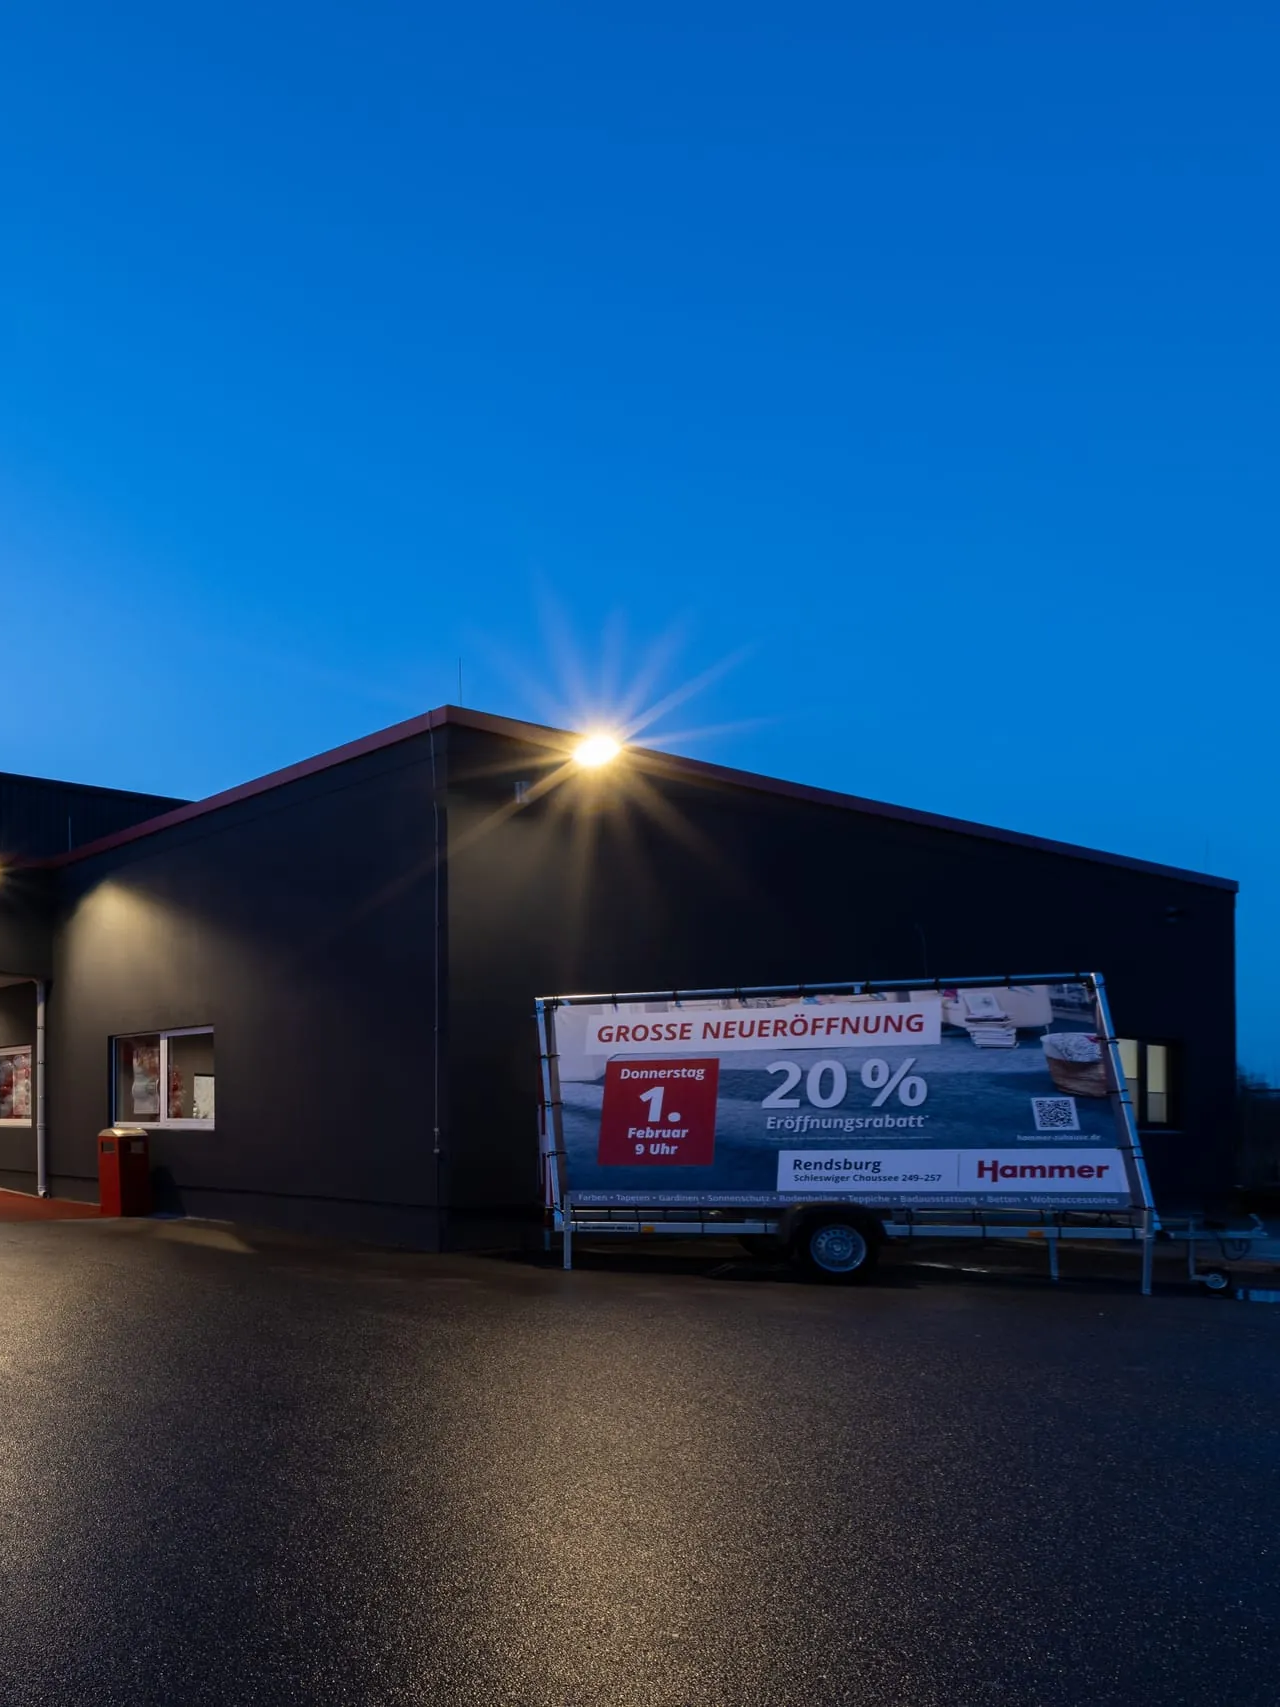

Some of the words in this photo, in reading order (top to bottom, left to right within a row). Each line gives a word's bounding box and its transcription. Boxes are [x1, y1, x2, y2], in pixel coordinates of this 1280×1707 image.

[598, 1022, 693, 1043] GROSSE
[702, 1013, 925, 1039] NEUERÖFFNUNG
[620, 1068, 706, 1081] Donnerstag
[761, 1060, 848, 1109] 20
[861, 1058, 928, 1107] %
[639, 1086, 682, 1123] 1.
[628, 1127, 689, 1139] Februar
[635, 1144, 645, 1155] 9
[649, 1143, 678, 1155] Uhr
[793, 1158, 881, 1173] Rendsburg
[977, 1160, 1109, 1182] Hammer
[794, 1174, 850, 1184] Schleswiger
[852, 1174, 899, 1182] Chaussee
[578, 1193, 608, 1201] Farben
[616, 1194, 650, 1203] Tapeten
[659, 1194, 699, 1202] Gardinen
[708, 1194, 769, 1202] Sonnenschutz
[848, 1195, 890, 1204] Teppiche
[901, 1196, 977, 1205] Badausstattung
[1030, 1196, 1119, 1204] Wohnaccessoires
